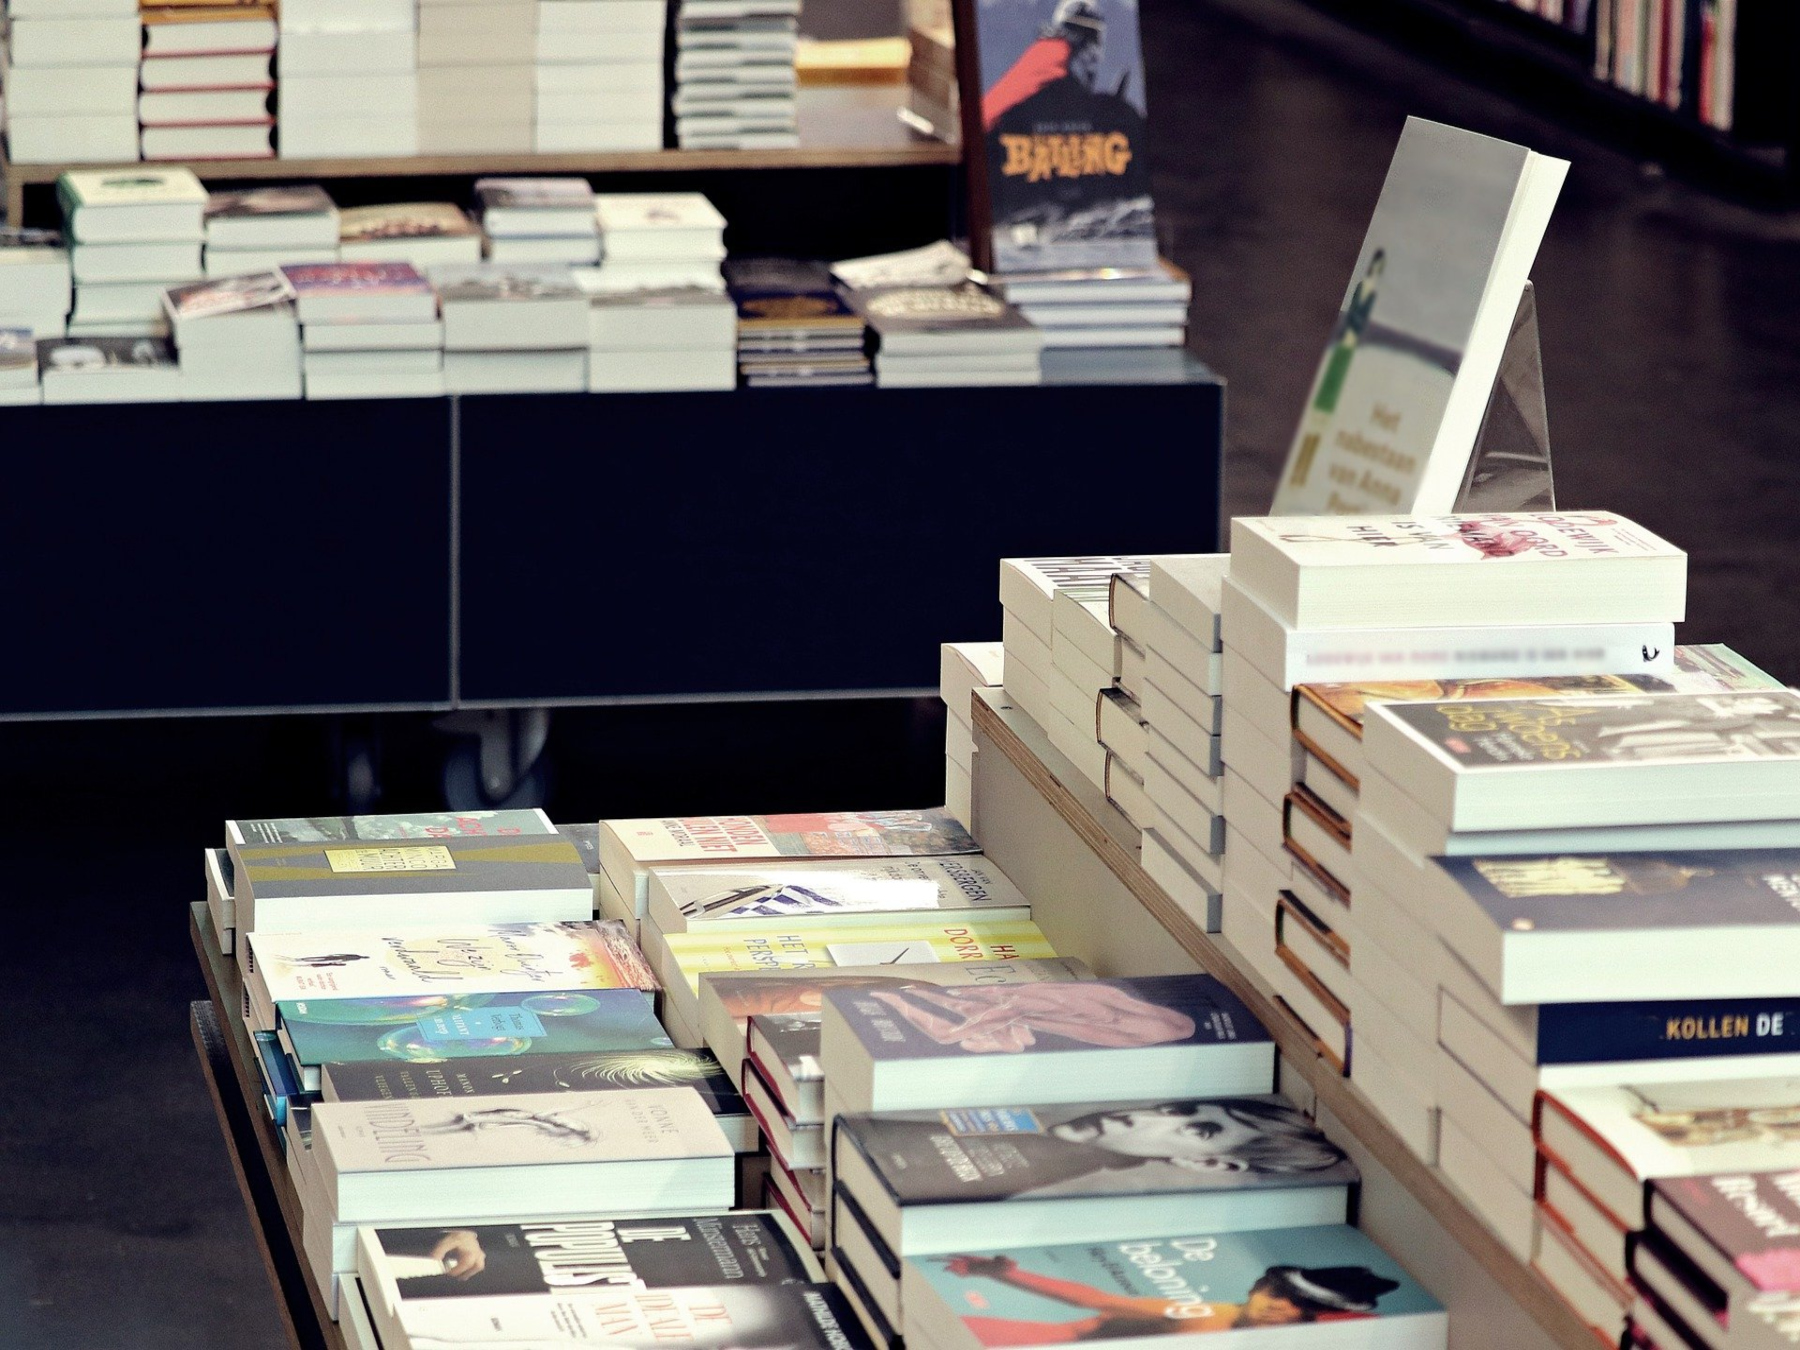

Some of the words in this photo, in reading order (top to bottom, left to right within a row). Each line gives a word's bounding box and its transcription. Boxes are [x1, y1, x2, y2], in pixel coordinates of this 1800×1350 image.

[1347, 525, 1398, 547] HIER
[1510, 530, 1568, 557] OORD
[1530, 513, 1619, 554] LODEWIJK
[696, 837, 738, 853] NIET
[741, 938, 786, 970] PERSPE
[774, 934, 812, 954] HET
[944, 928, 984, 960] DORR
[1665, 1013, 1749, 1040] KOLLEN
[1755, 1012, 1784, 1037] DE
[616, 1225, 692, 1244] DE
[1170, 1237, 1218, 1262] De
[1118, 1241, 1216, 1320] beloning
